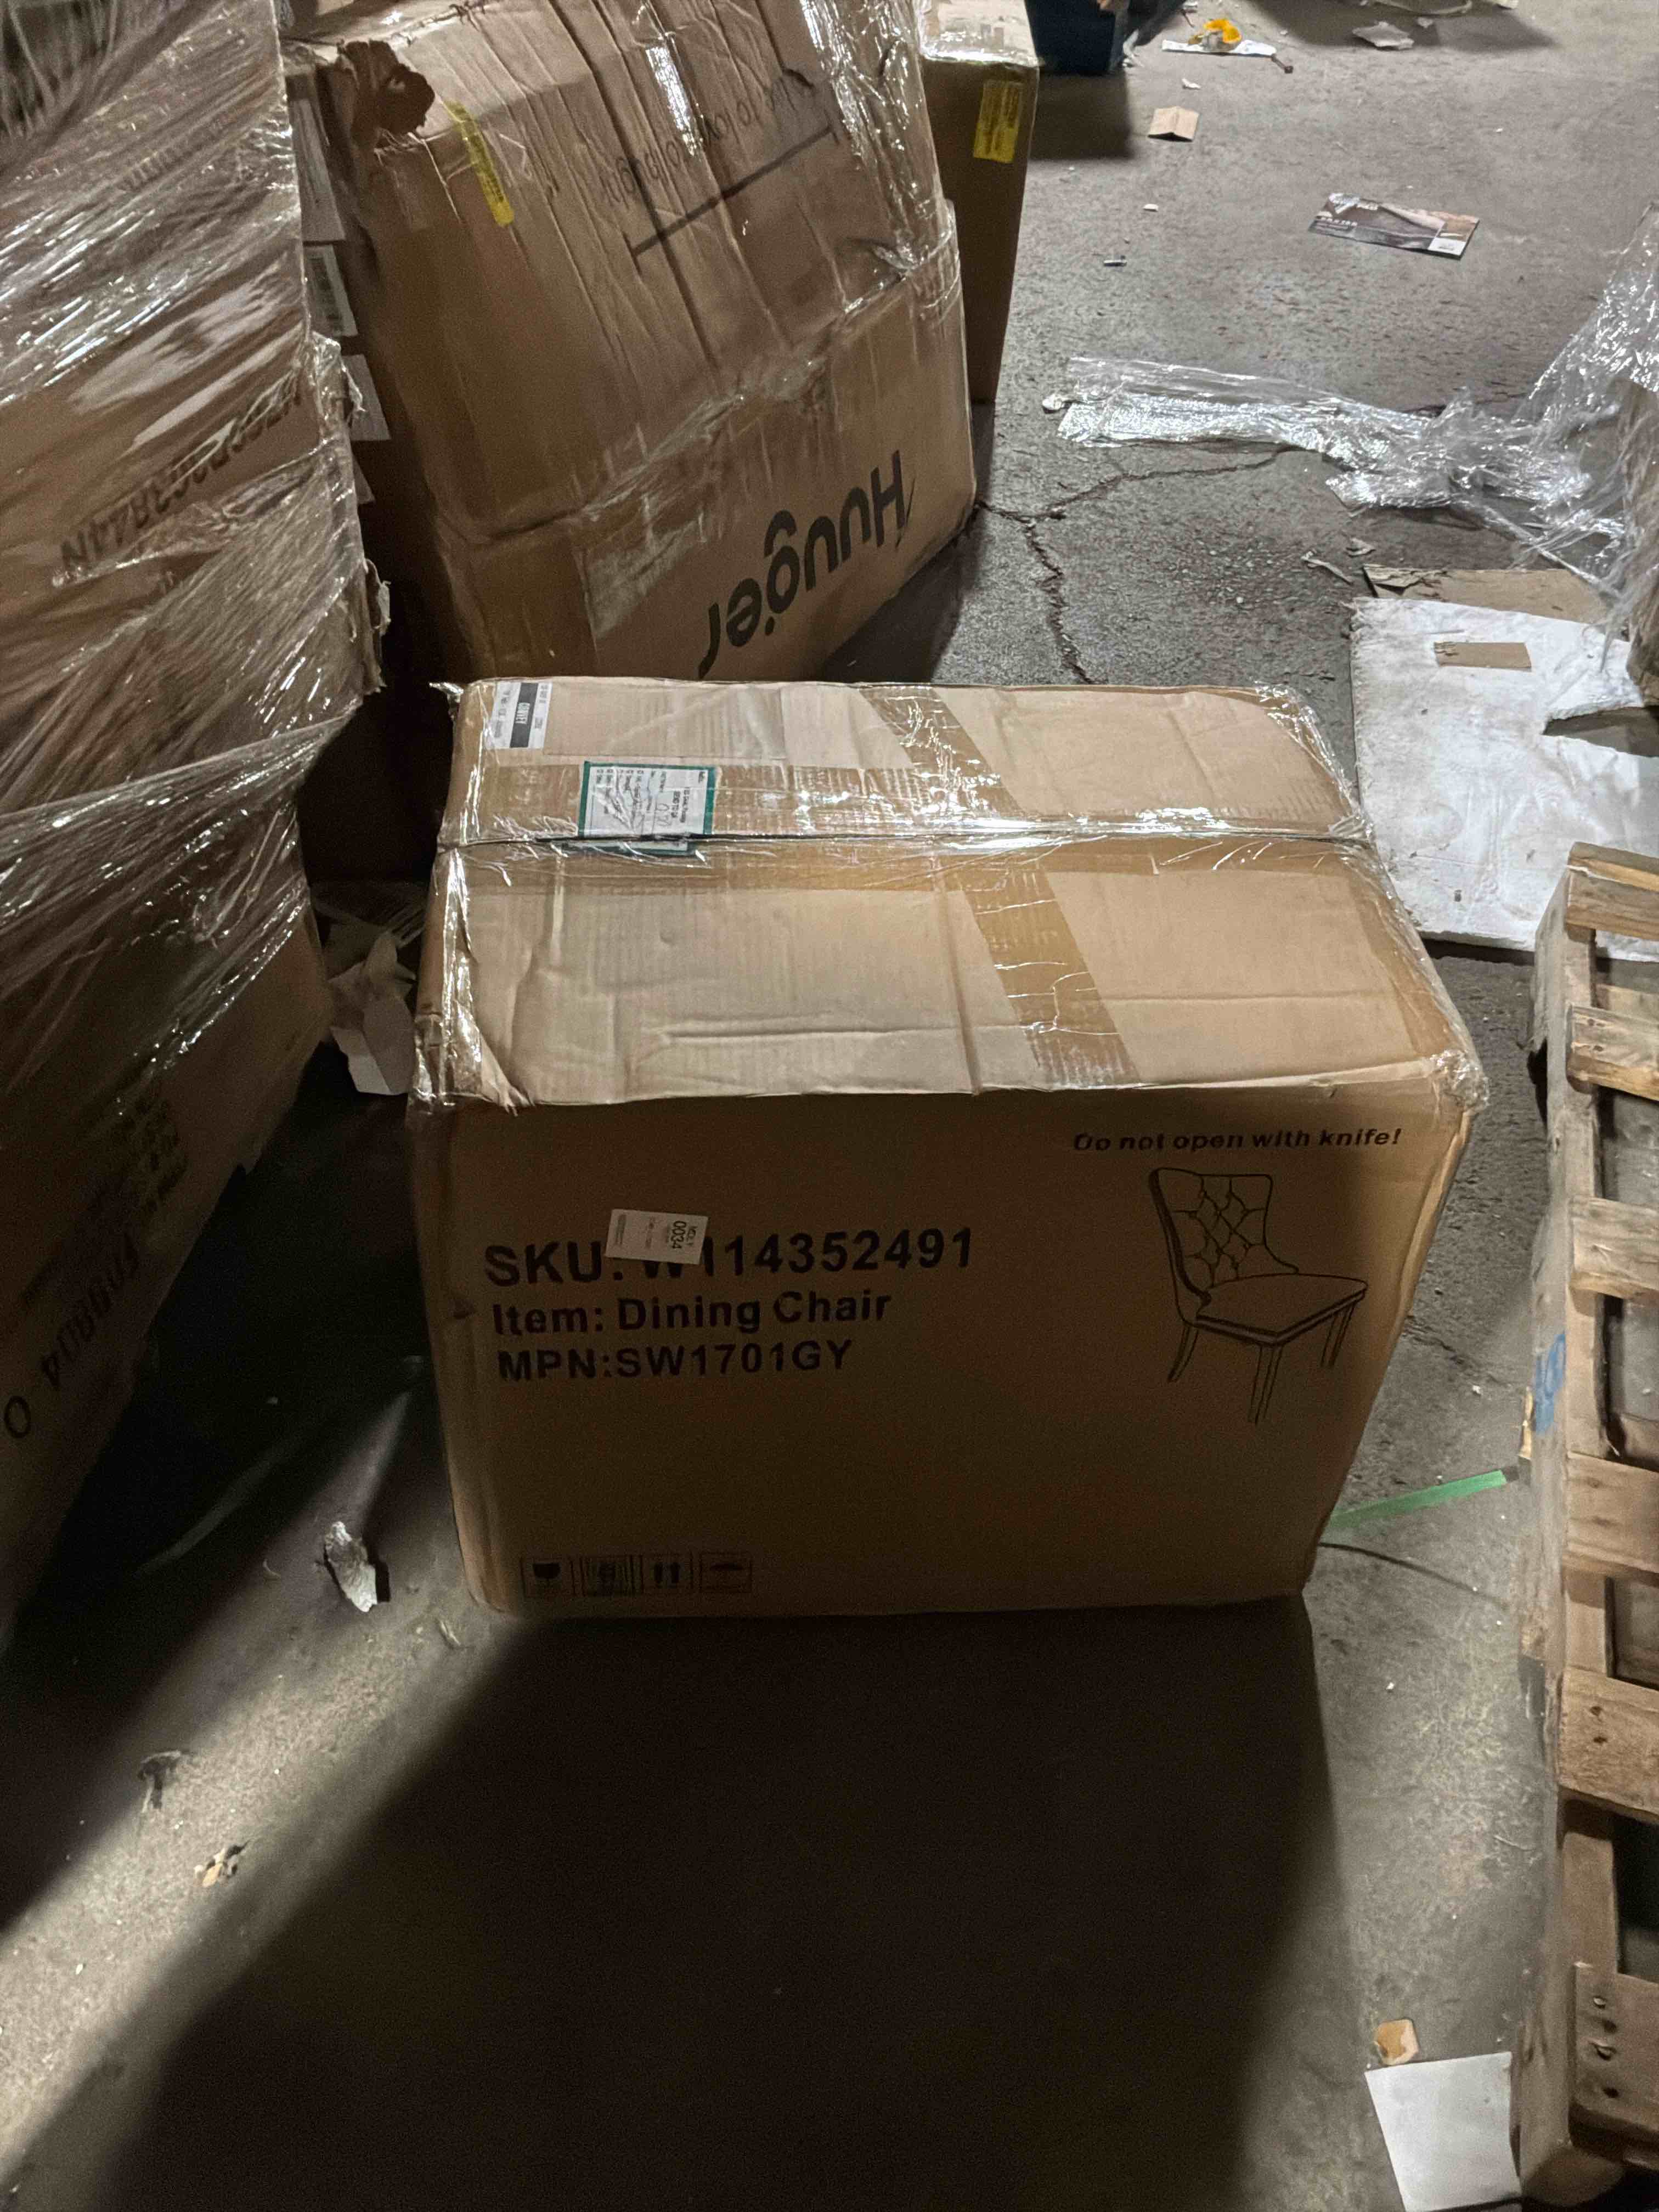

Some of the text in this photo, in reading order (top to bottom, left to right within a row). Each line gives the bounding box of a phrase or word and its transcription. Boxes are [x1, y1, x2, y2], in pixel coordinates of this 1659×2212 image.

[698, 449, 906, 680] Huuger
[1074, 1128, 1402, 1153] Do not open with knife!
[671, 1221, 686, 1249] 0034
[492, 1288, 893, 1336] Item: Dining Chair
[498, 1339, 853, 1382] MPN:SW1701GY
